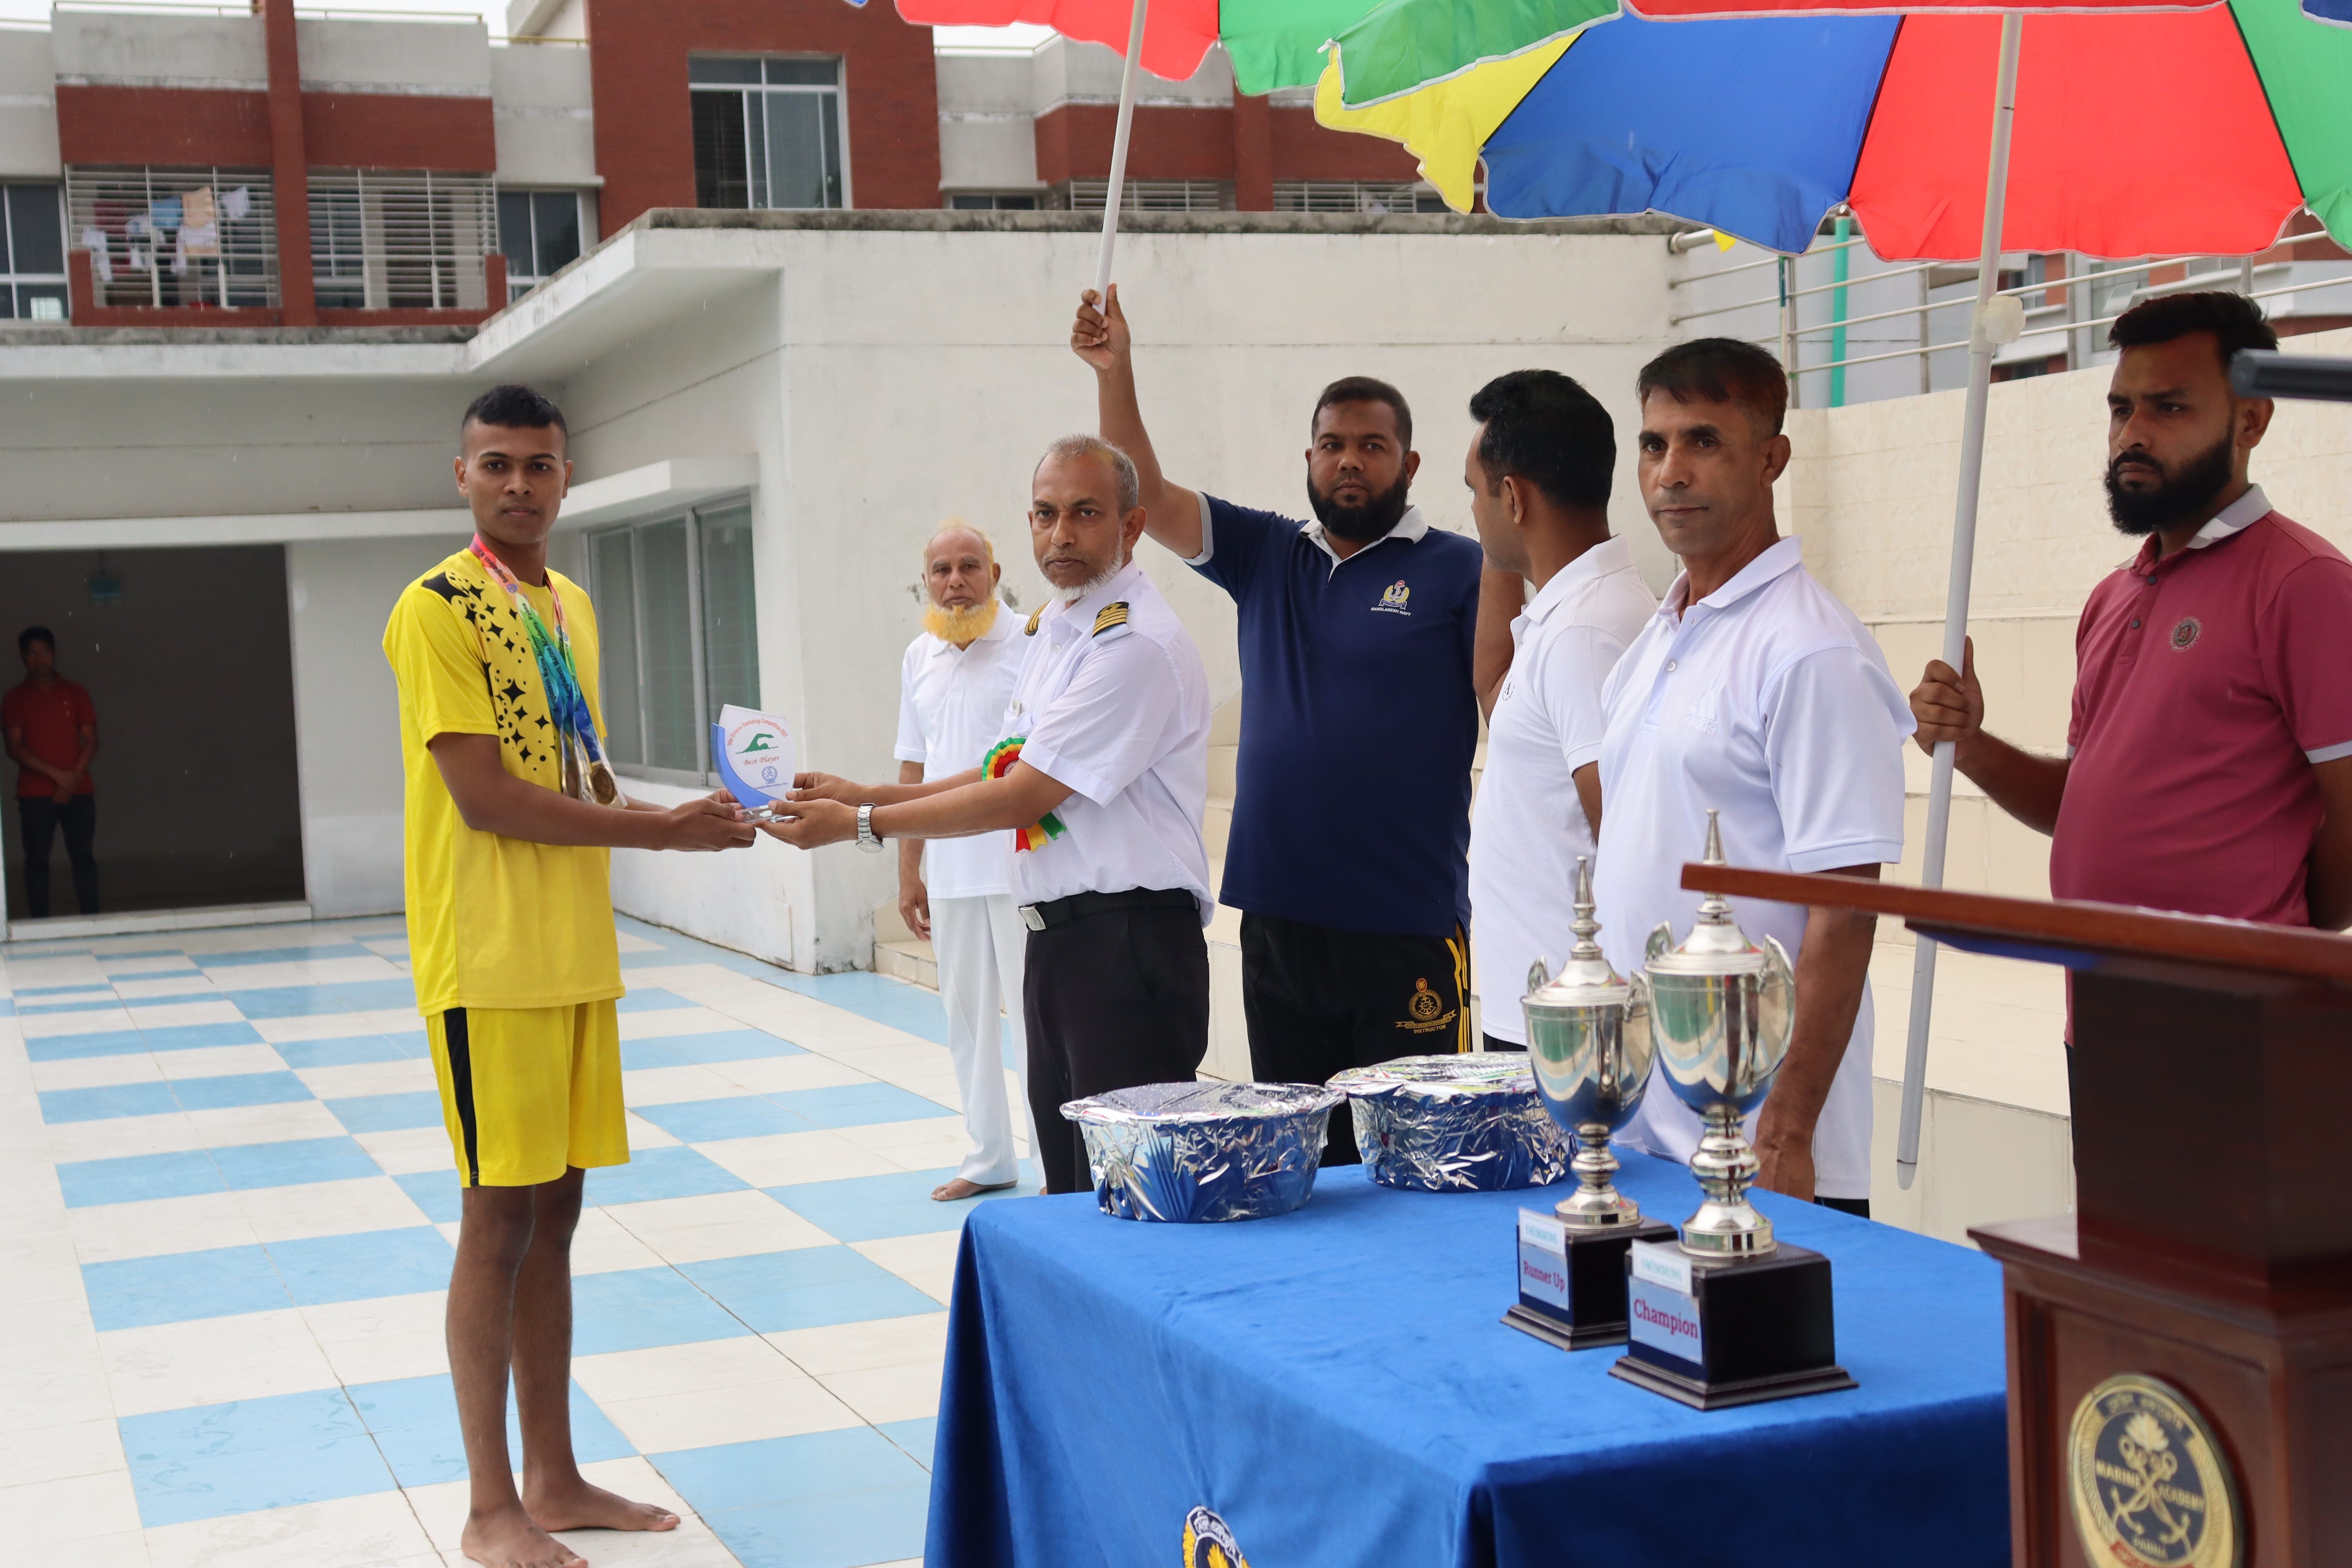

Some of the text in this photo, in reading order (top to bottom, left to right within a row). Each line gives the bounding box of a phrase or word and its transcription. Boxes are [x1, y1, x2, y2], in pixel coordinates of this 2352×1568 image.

[522, 603, 533, 620] Pabna
[547, 647, 559, 666] Marine
[539, 657, 548, 677] Marine
[730, 725, 743, 738] Division
[742, 718, 760, 727] Swimming
[759, 755, 780, 764] Player
[1414, 1024, 1446, 1033] INSTRUCTOR
[1553, 1268, 1565, 1293] Up
[1634, 1299, 1699, 1339] Champion
